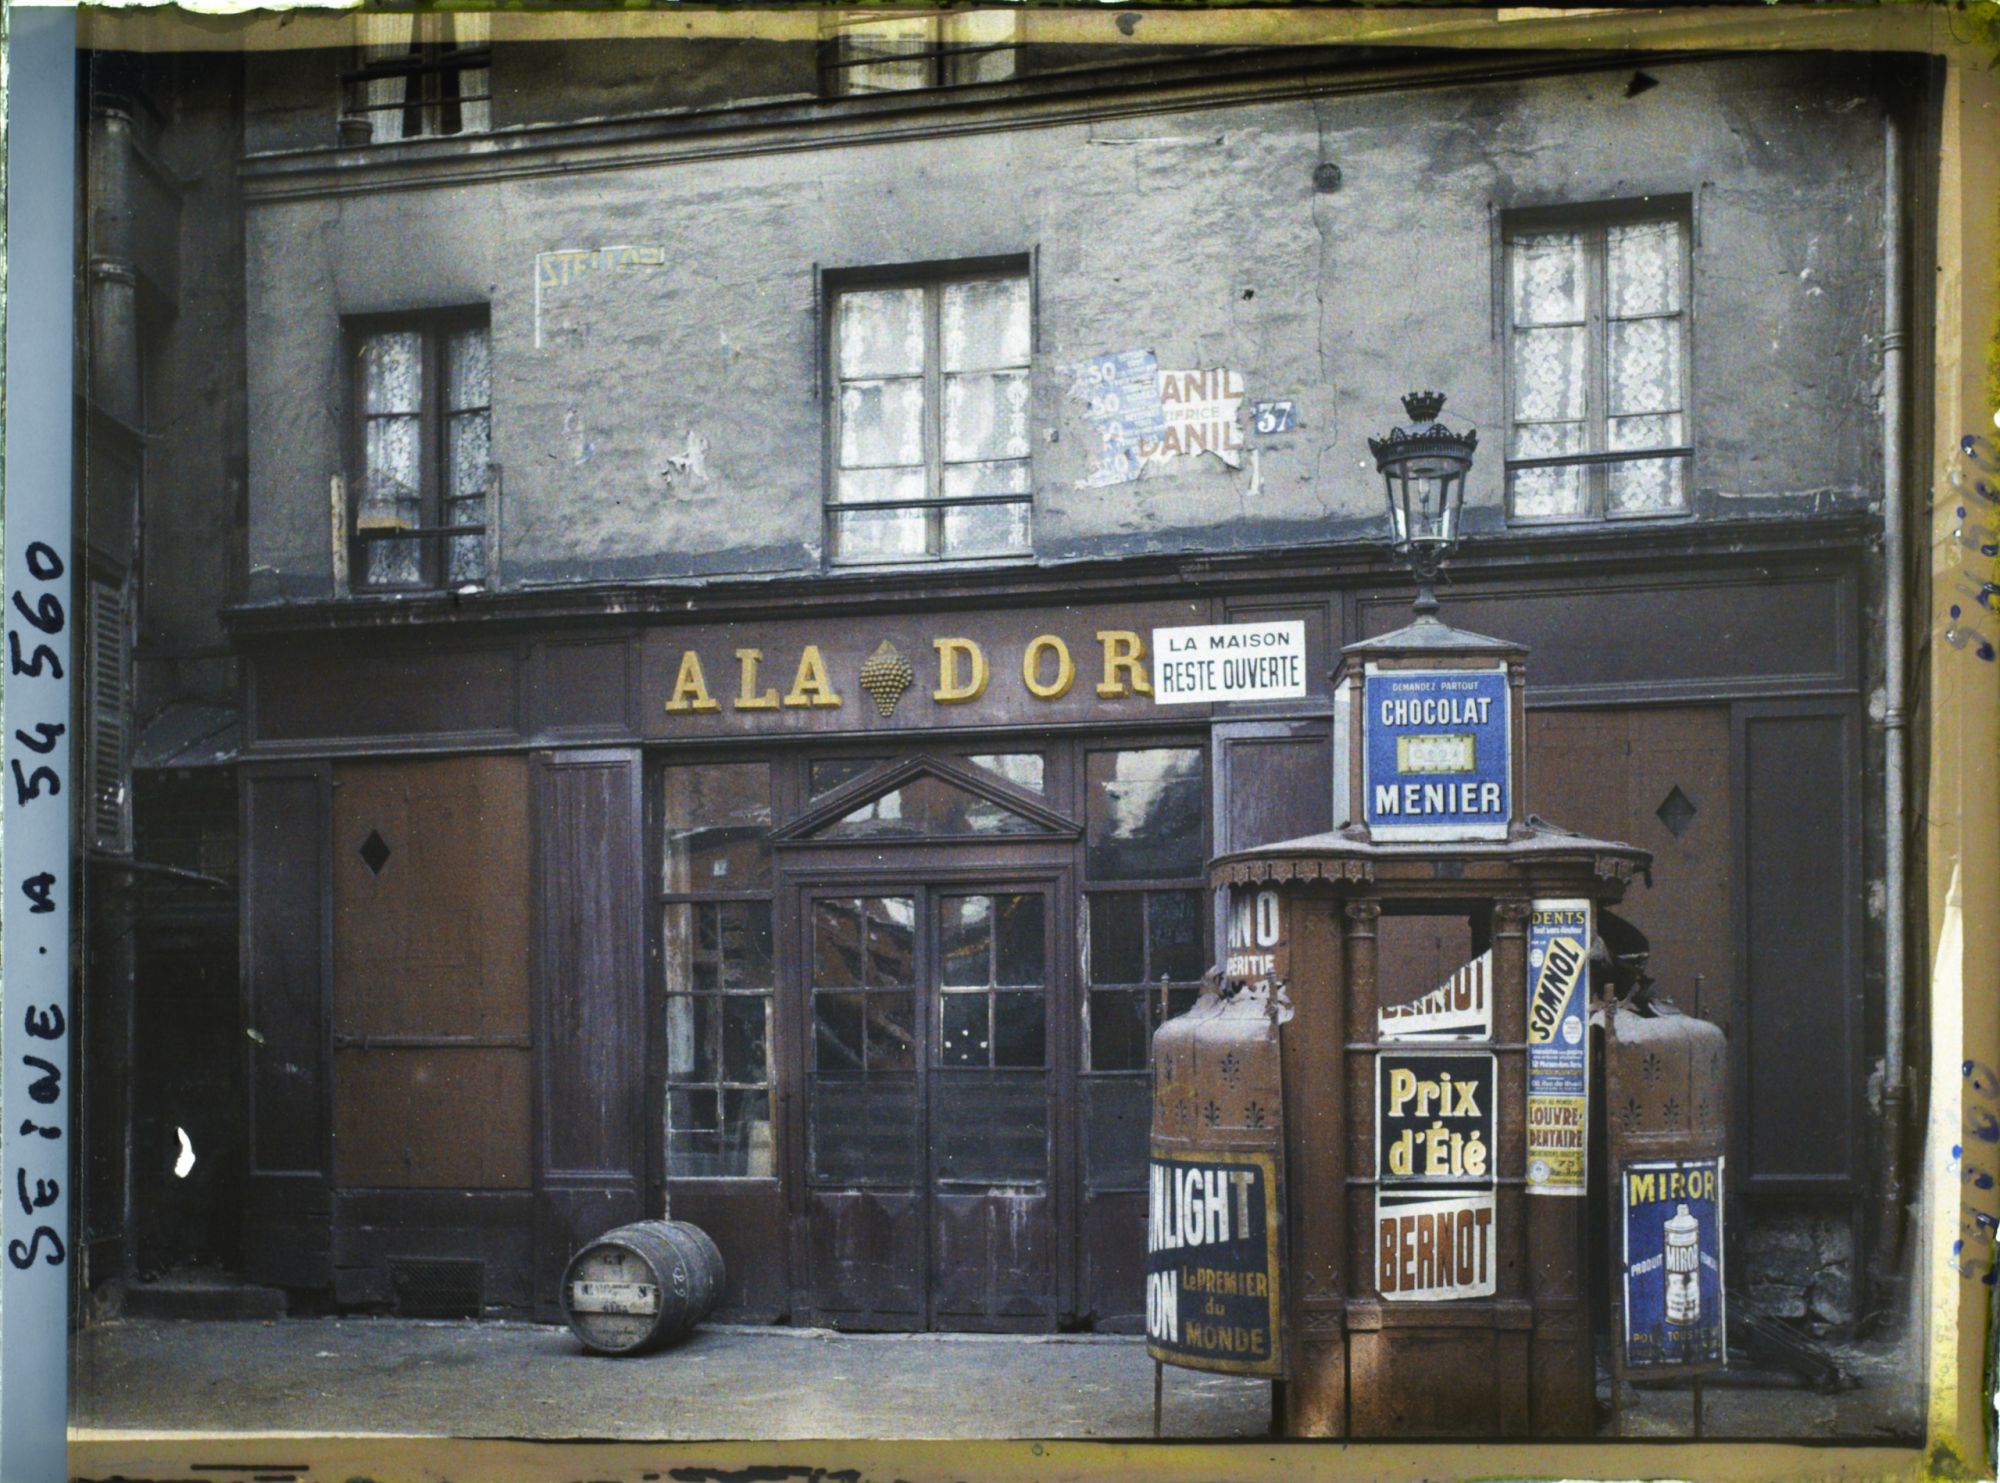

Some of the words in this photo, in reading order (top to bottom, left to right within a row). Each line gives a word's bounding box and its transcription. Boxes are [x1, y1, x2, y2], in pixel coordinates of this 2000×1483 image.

[1161, 369, 1244, 404] ANIL
[1257, 402, 1292, 433] 37
[1169, 636, 1197, 652] LA
[1211, 632, 1291, 650] MAISON
[1162, 661, 1218, 693] RESTE
[1223, 654, 1301, 689] OUVERTE
[1392, 682, 1436, 691] DEMANDEZ
[1441, 681, 1479, 690] PARTOUT
[1381, 697, 1492, 727] CHOCOLAT
[1376, 782, 1502, 815] MENIER
[1532, 911, 1585, 924] DENTS
[1530, 939, 1580, 1041] SOMNOL
[1388, 1068, 1482, 1117] Prix
[9, 1004, 66, 1269] SEINE
[1388, 1120, 1487, 1177] d'Été
[1529, 1128, 1583, 1148] DENTAIRE
[1630, 1170, 1715, 1206] MIROR
[1380, 1207, 1492, 1293] BERNOT
[1147, 1270, 1178, 1343] ON
[1205, 1297, 1225, 1315] du
[1185, 1320, 1265, 1354] MONDE
